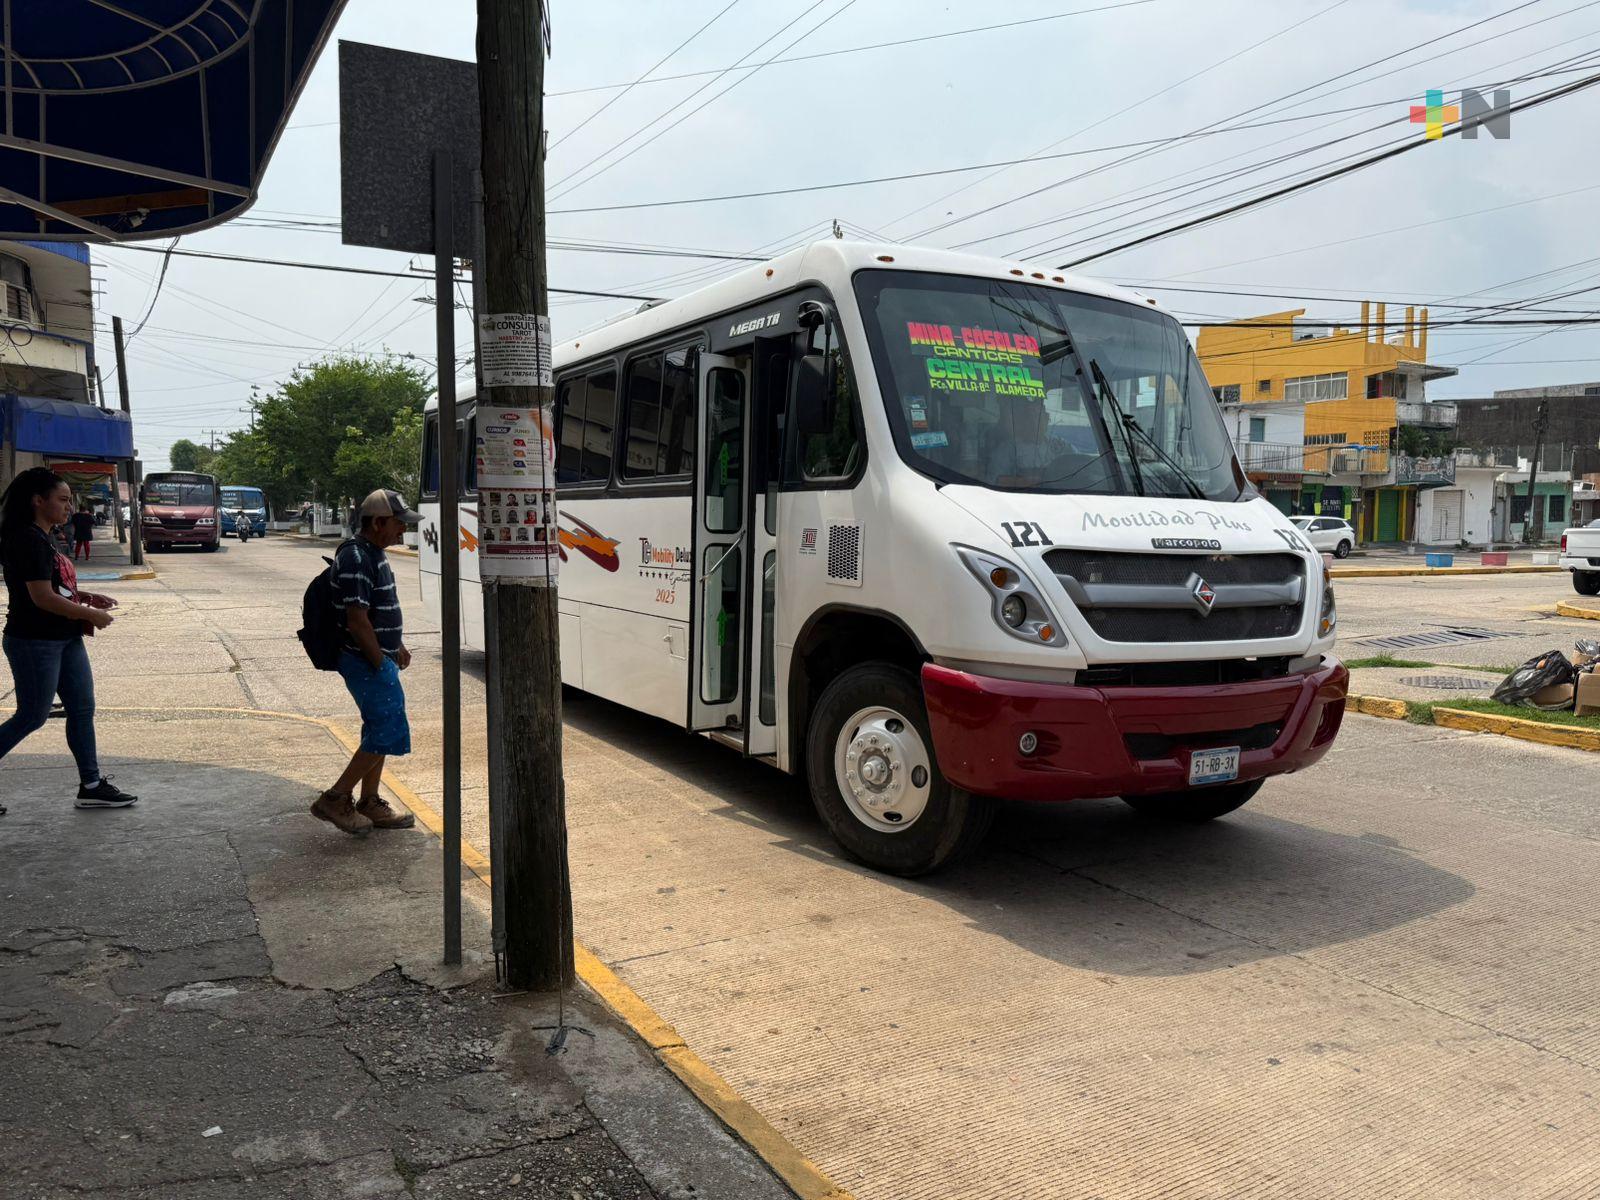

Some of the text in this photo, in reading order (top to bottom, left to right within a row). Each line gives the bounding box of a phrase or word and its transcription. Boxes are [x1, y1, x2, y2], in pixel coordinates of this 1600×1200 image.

[496, 321, 544, 332] CONSULTAS
[511, 329, 532, 337] TAROT
[729, 317, 765, 337] MEGA
[933, 345, 1023, 364] CANTICAS
[926, 358, 1044, 388] CENTRAL
[995, 384, 1046, 398] ALAMEDA
[1081, 510, 1252, 532] Movilidad Plus
[1001, 521, 1054, 548] 121
[1154, 538, 1220, 550] Marcopolo
[675, 546, 692, 563] Delu
[655, 588, 676, 605] 2025
